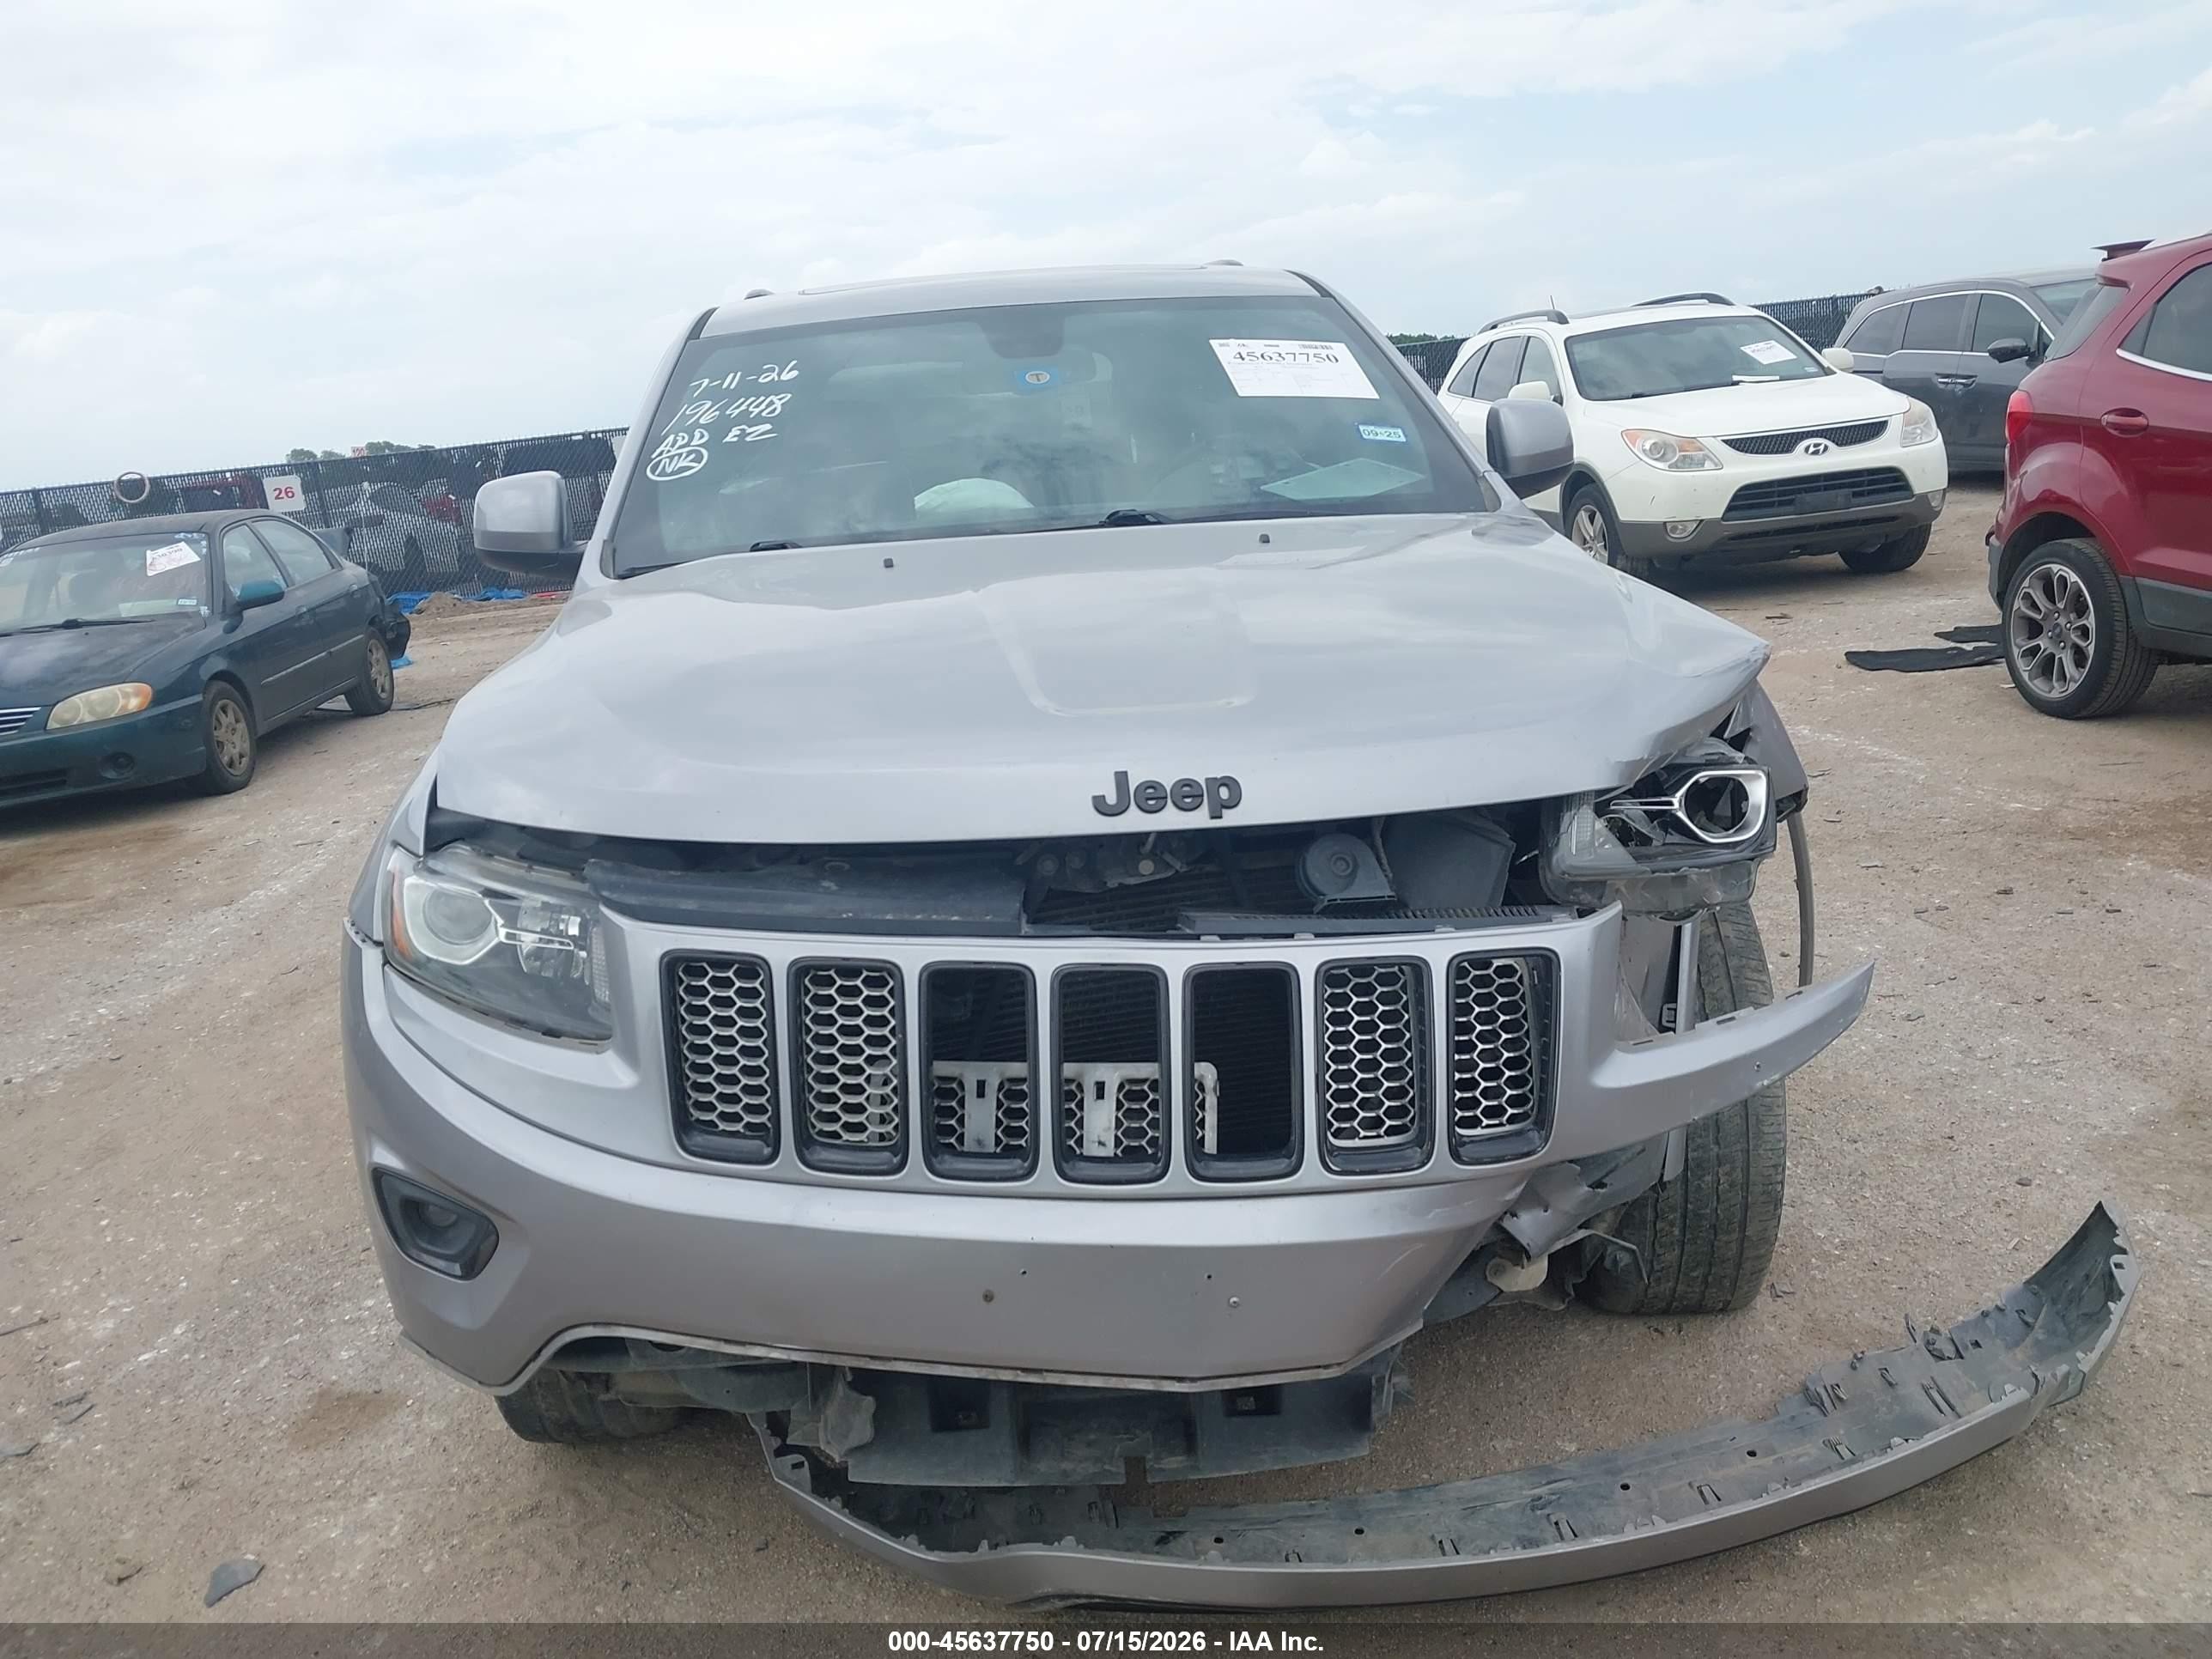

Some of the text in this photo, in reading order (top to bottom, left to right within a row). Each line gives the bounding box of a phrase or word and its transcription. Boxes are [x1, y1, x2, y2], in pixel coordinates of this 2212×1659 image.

[1233, 351, 1340, 364] 45637750
[689, 360, 799, 398] 7-11-26
[722, 423, 779, 443] EZ
[272, 486, 296, 501] 26
[1091, 770, 1243, 820] Jeep
